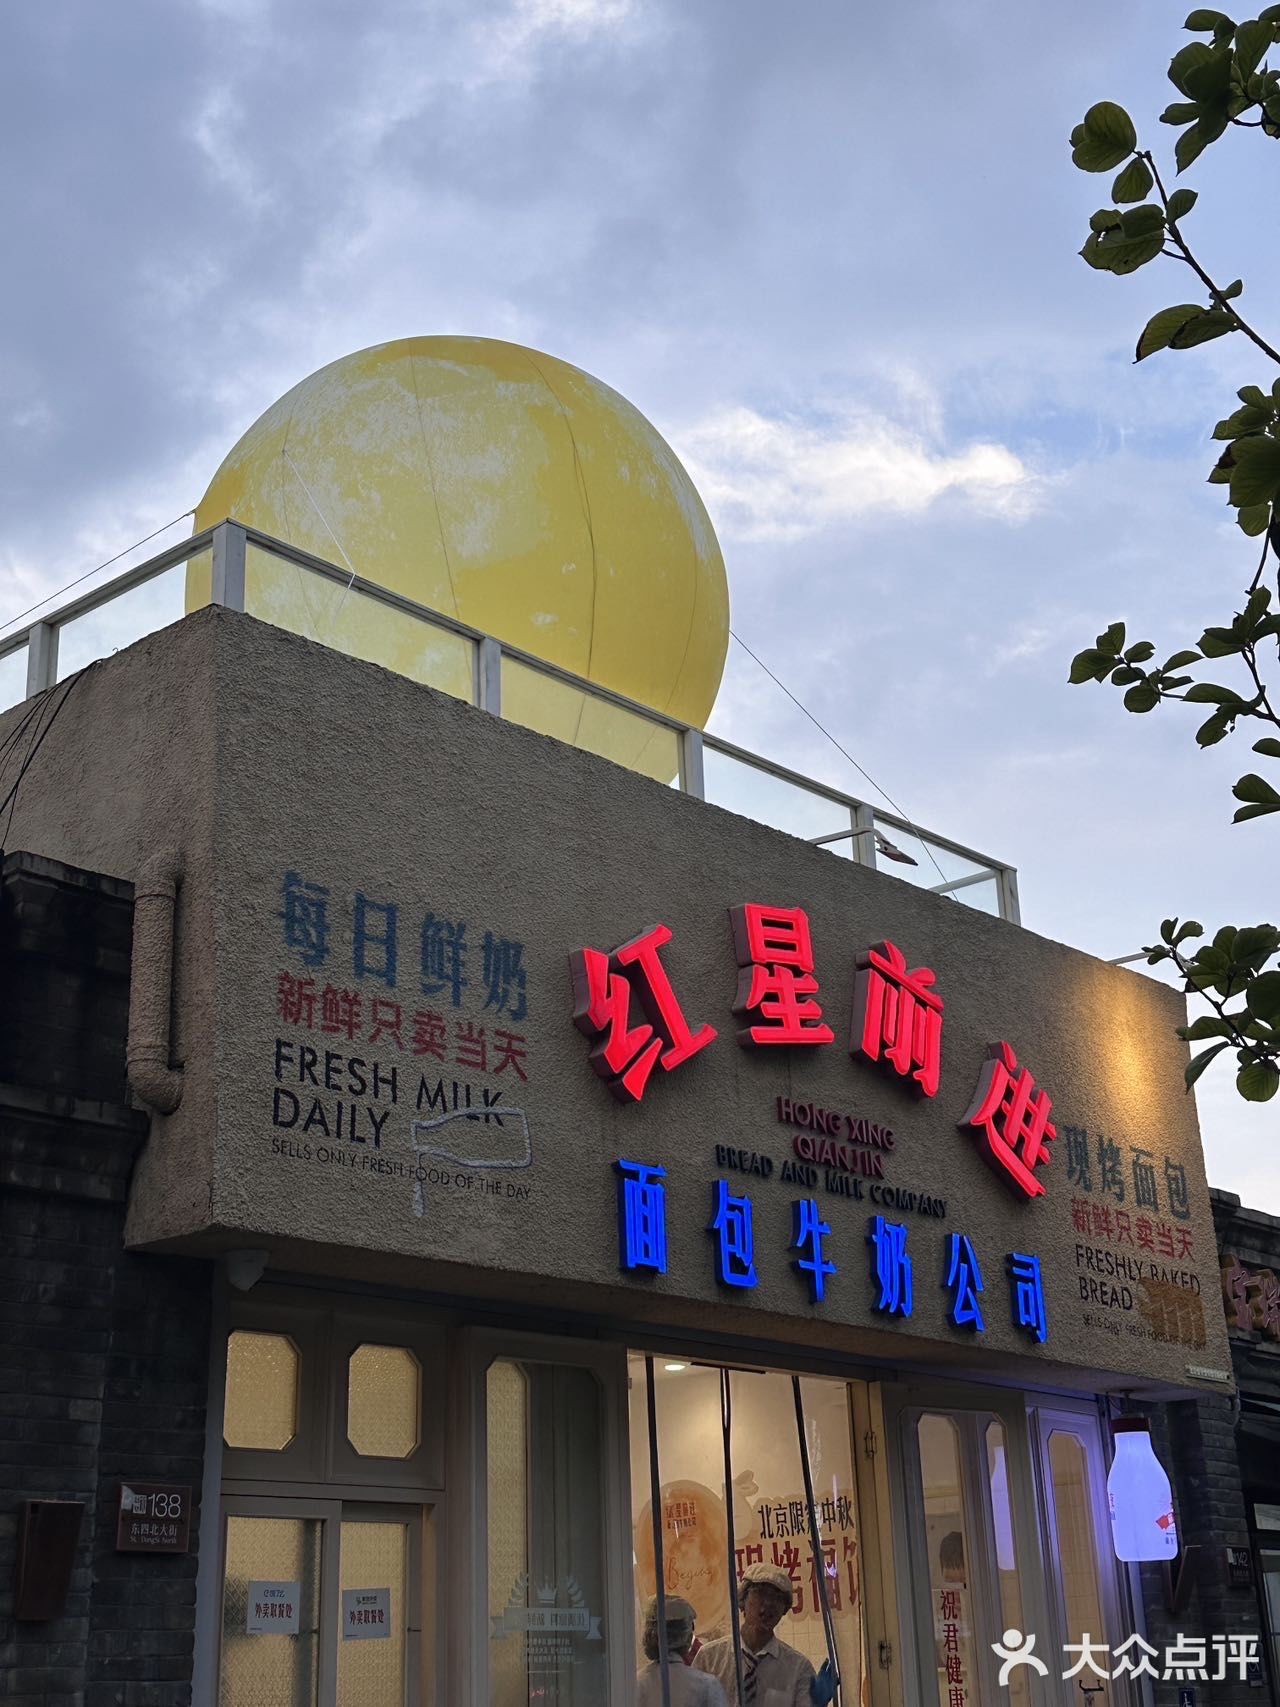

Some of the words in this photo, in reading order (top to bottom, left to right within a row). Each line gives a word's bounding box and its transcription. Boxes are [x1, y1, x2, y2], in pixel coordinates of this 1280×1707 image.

[278, 870, 529, 1021] 每日鲜奶
[276, 970, 529, 1082] 新鲜只卖当天
[568, 903, 1056, 1198] 红星前进
[274, 1037, 398, 1104] FRESH
[416, 1074, 504, 1127] MILK
[272, 1087, 390, 1150] DAILY
[776, 1095, 842, 1136] HONG
[845, 1116, 896, 1151] XING
[272, 1138, 311, 1160] SELLS
[316, 1147, 357, 1168] ONLY
[362, 1155, 406, 1178] FRESH
[408, 1165, 450, 1186] FOOD
[454, 1173, 475, 1190] OF
[479, 1177, 502, 1195] THE
[507, 1183, 531, 1199] DAY
[715, 1144, 773, 1177] BREAD
[780, 1160, 818, 1188] AND
[825, 1169, 864, 1201] MILK
[869, 1184, 948, 1219] COMPANY
[1063, 1124, 1191, 1221] 现烤面包
[614, 1158, 1047, 1344] 面包牛奶公司
[1071, 1195, 1196, 1263] 新鲜只卖当天
[1075, 1243, 1143, 1281] FRESHLY
[1079, 1275, 1133, 1310] BREAD
[131, 1523, 178, 1537] 东四北大街
[148, 1493, 181, 1518] 138
[255, 1602, 293, 1619] 外卖取餐处
[349, 1608, 385, 1625] 外卖取餐处
[940, 1589, 964, 1707] 祝君健康
